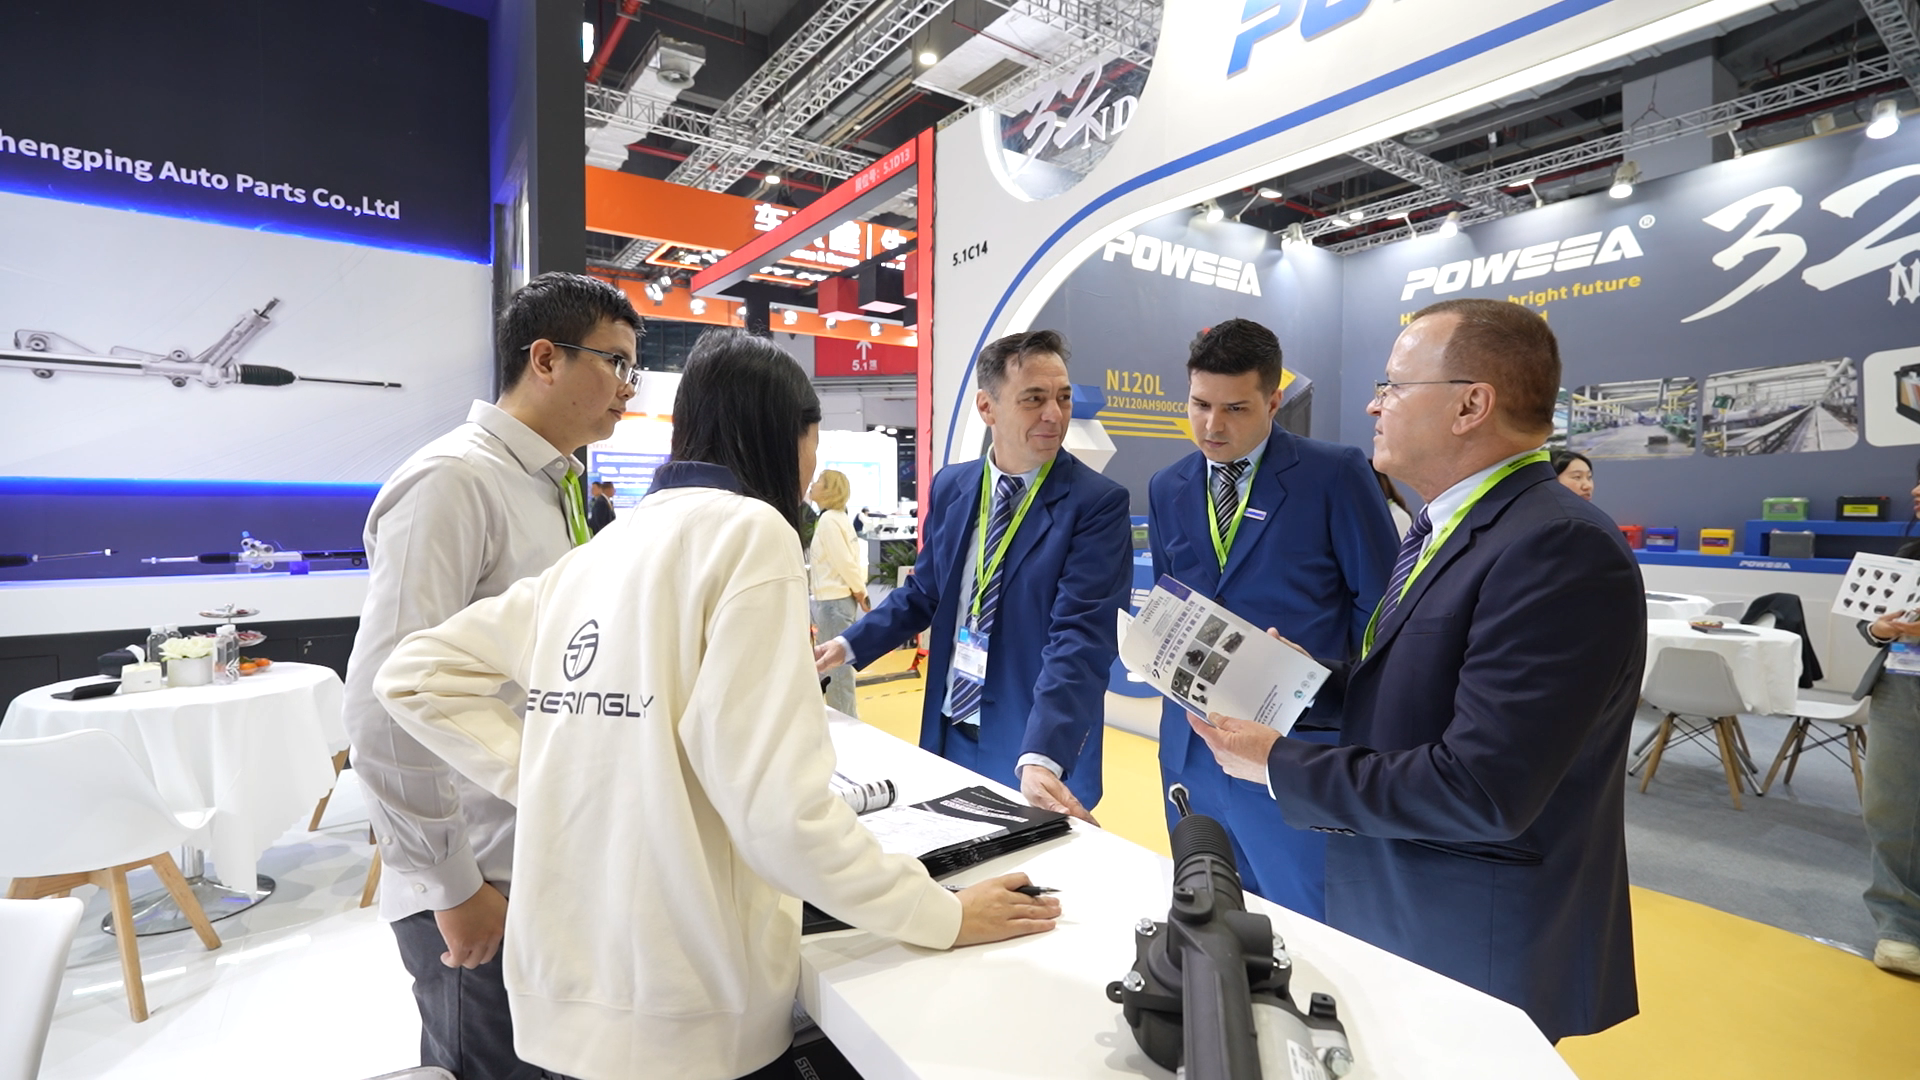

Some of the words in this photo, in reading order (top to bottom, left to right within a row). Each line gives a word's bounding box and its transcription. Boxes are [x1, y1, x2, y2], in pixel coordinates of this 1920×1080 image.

[0, 129, 153, 182] hengping
[159, 161, 229, 190] Auto
[236, 173, 306, 203] Parts
[312, 188, 400, 219] Co.,Ltd
[883, 148, 911, 175] 5.1D13
[952, 241, 988, 266] 5.1C14
[1103, 230, 1262, 297] POWSEA
[1401, 224, 1644, 301] POWSEA
[1572, 275, 1642, 297] future
[1106, 369, 1165, 396] N120L
